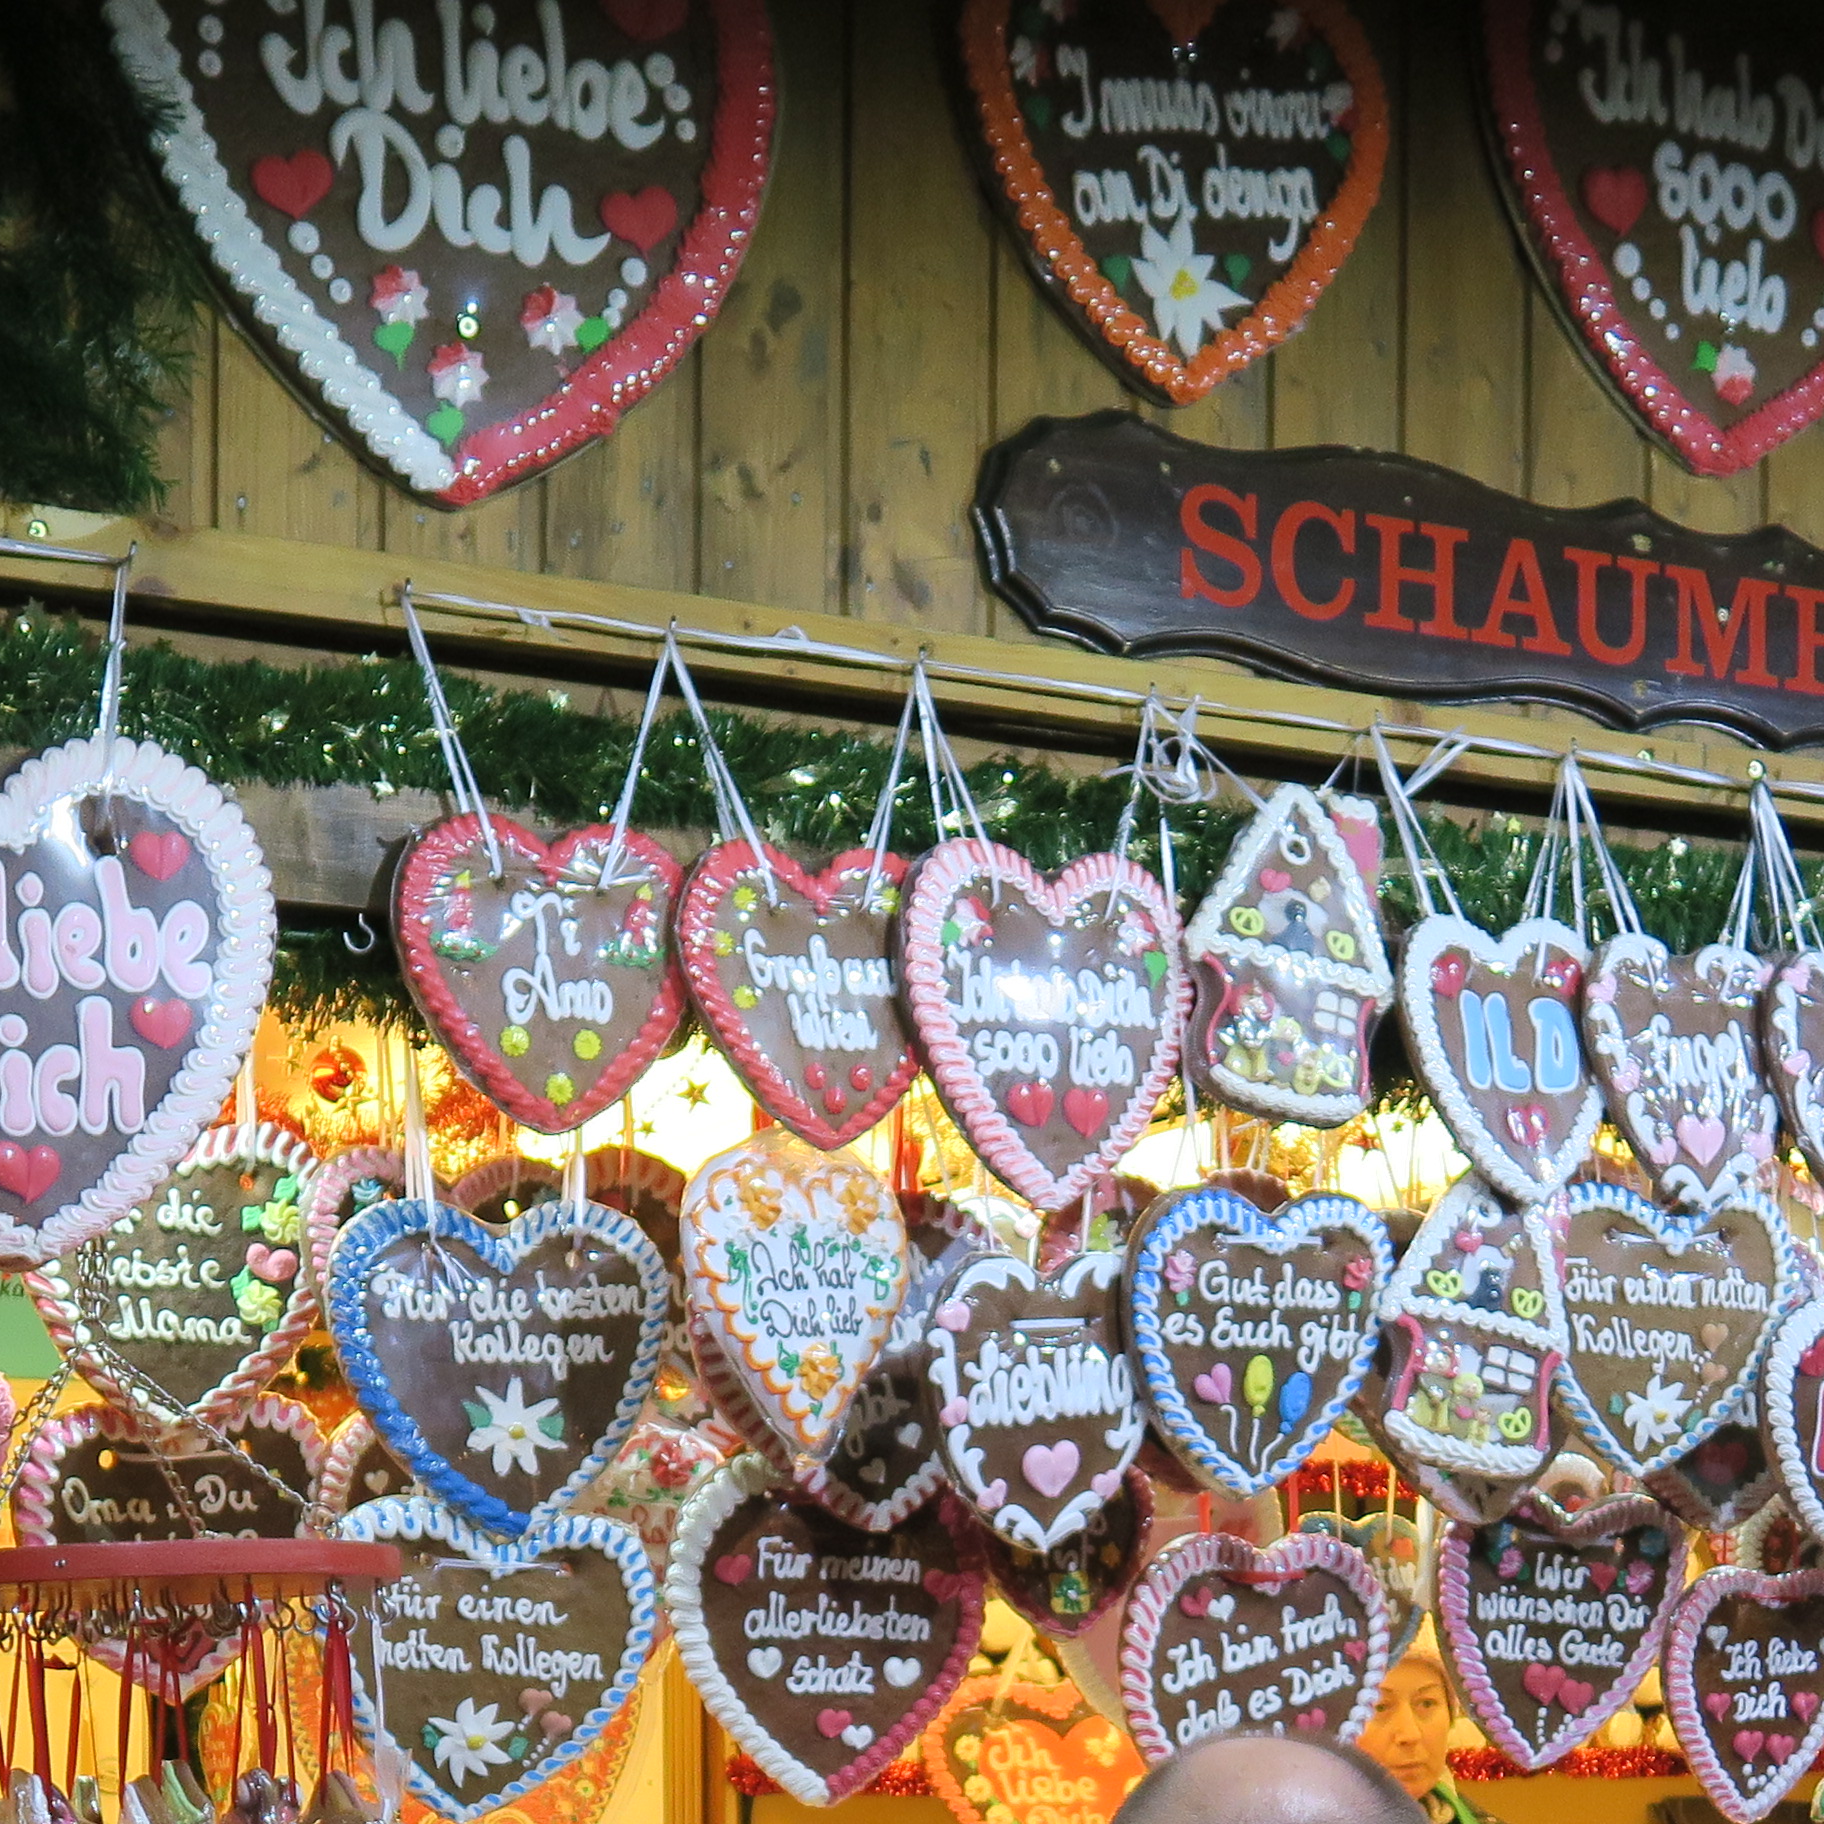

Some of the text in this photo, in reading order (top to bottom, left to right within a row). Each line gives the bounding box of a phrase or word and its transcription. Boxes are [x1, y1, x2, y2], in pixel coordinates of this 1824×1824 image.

[329, 108, 611, 268] Dich
[500, 952, 613, 1025] Amo
[974, 1025, 1134, 1087] sooo lieb
[156, 1188, 223, 1236] die
[751, 1241, 810, 1296] Ich
[1198, 1260, 1341, 1309] Gut dass
[108, 1294, 252, 1345] Mama
[469, 1276, 533, 1322] die
[535, 1270, 646, 1321] besten
[760, 1298, 825, 1339] Dich
[448, 1319, 614, 1381] Kollegen
[1161, 1306, 1360, 1374] es Euch gibt
[1571, 1313, 1697, 1375] Kollegen
[963, 1338, 1133, 1450] Liebling
[61, 1476, 157, 1525] Oma
[757, 1536, 813, 1580] Für
[1536, 1552, 1590, 1590] Wir
[457, 1584, 569, 1626] einen
[744, 1590, 931, 1641] allerliebsten
[1607, 1593, 1650, 1632] Dir
[480, 1632, 604, 1699] Kollegen
[1162, 1637, 1218, 1694] Ich
[1220, 1624, 1278, 1673] bin
[1486, 1624, 1624, 1667] alles Gute
[1721, 1639, 1762, 1682] Ich
[786, 1651, 875, 1694] Schatz
[1248, 1685, 1283, 1720] es
[1281, 1651, 1356, 1705] Dich
[1733, 1682, 1787, 1722] Dich
